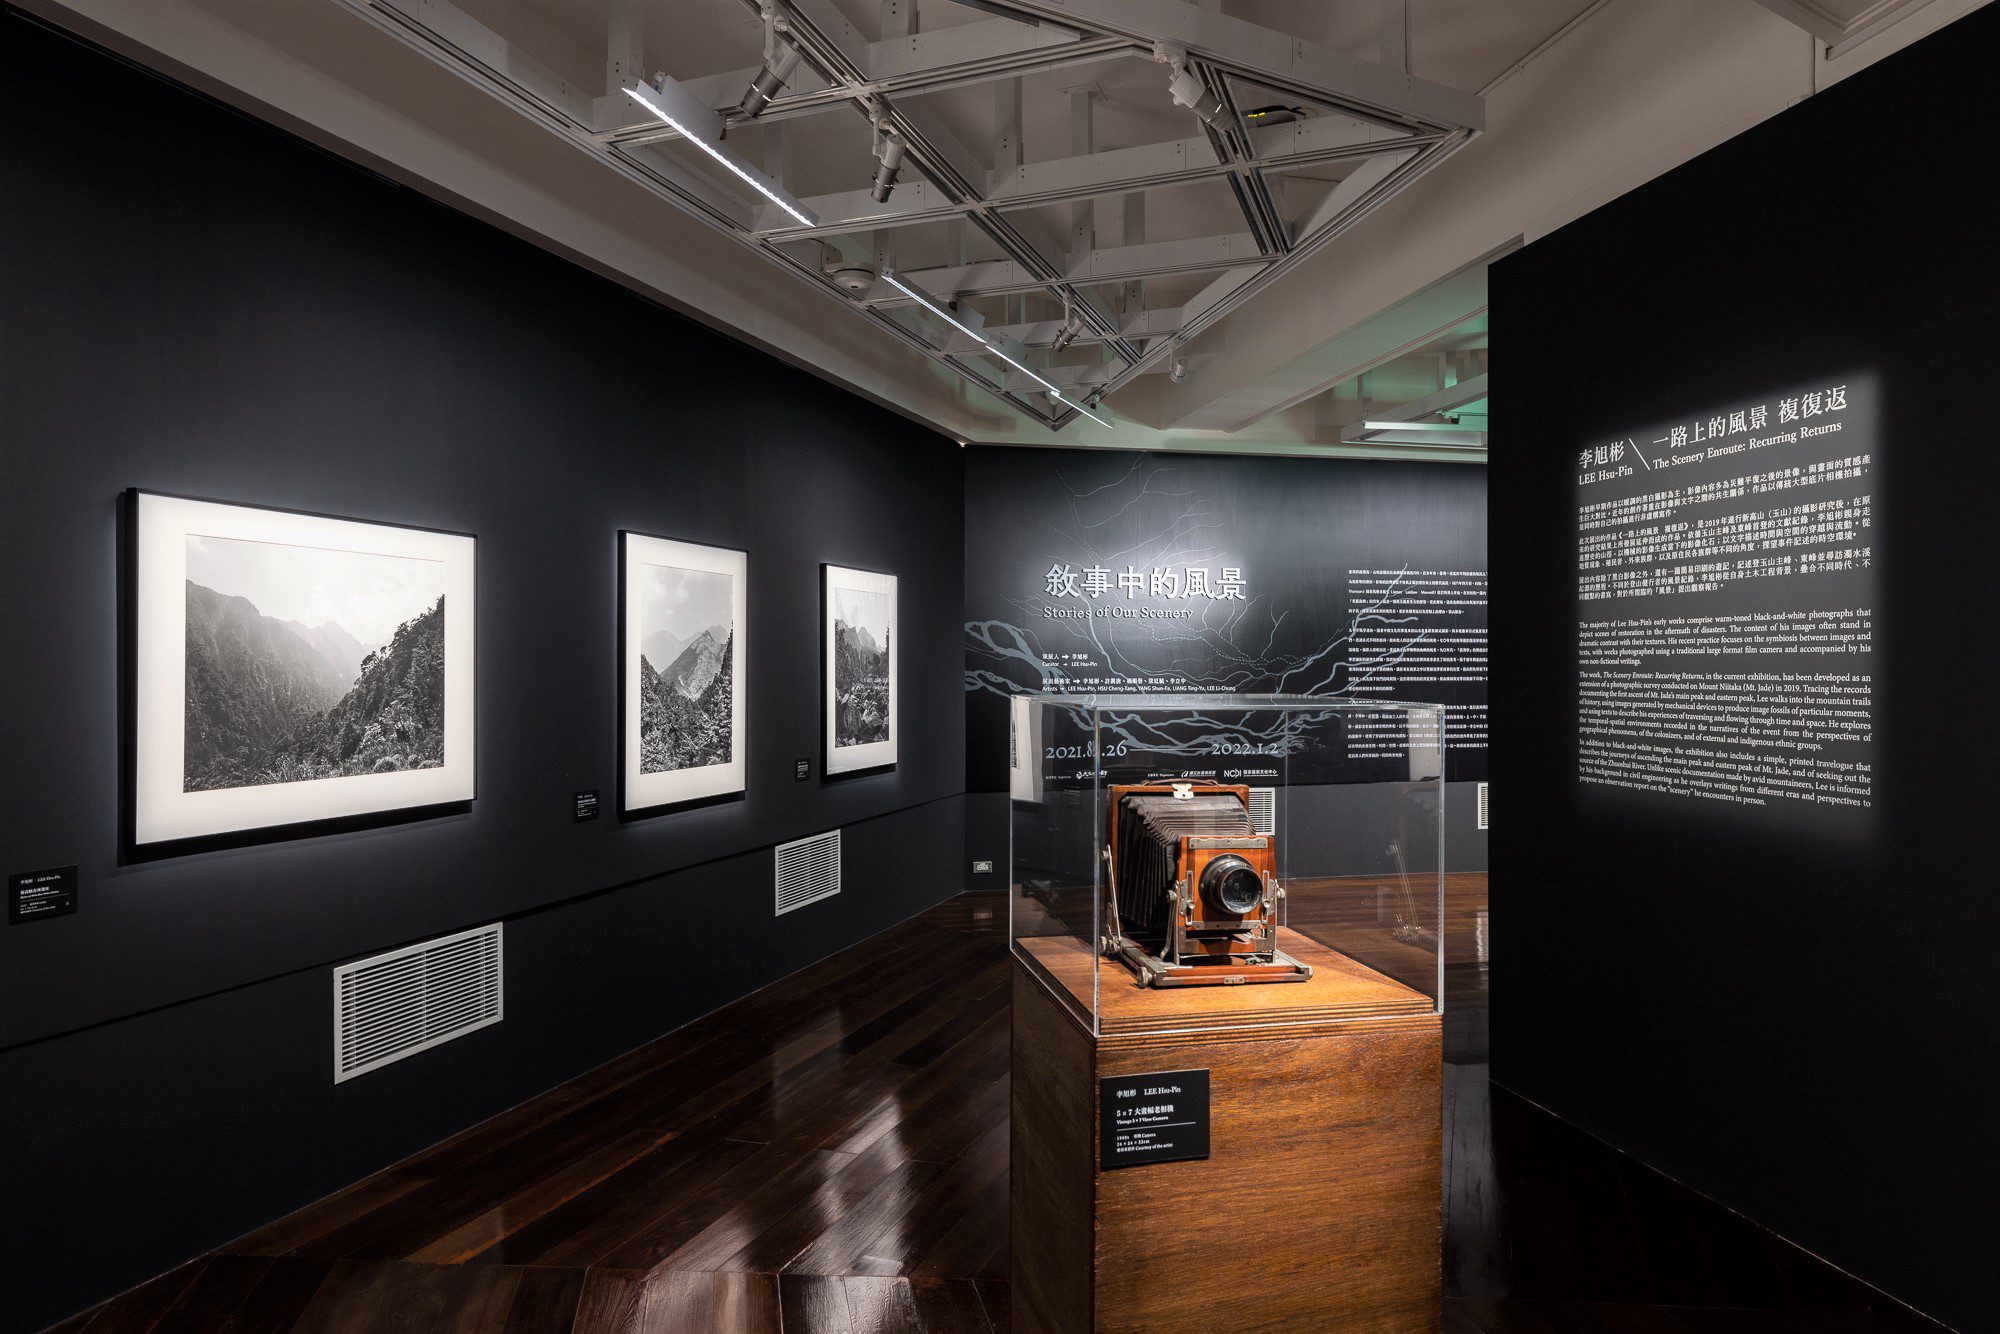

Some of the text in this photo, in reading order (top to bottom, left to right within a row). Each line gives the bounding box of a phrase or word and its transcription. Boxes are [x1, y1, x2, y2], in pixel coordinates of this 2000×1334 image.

[1652, 384, 1847, 448] 一路上的風景 複復返
[1652, 422, 1842, 469] The Scenery Enroute: Recurring Returns
[1579, 440, 1624, 469] 李旭彬
[1578, 464, 1633, 485] LEE Hsu-Pin
[1045, 563, 1246, 600] 敘事中的風景
[1043, 606, 1193, 621] Stories of Our Scenery
[1753, 607, 1871, 621] black-and-white photographs that
[1769, 619, 1871, 632] of his images often stand in
[1765, 631, 1871, 644] symbiosis between images and
[1784, 644, 1797, 653] and
[1799, 643, 1846, 654] accompanied
[1848, 643, 1858, 654] by
[1859, 643, 1871, 652] his
[1746, 672, 1781, 681] exhibition,
[1782, 672, 1794, 681] has
[1795, 672, 1812, 681] been
[1813, 672, 1850, 684] developed
[1757, 683, 1774, 693] Jade)
[1783, 684, 1801, 692] 2019.
[1802, 684, 1829, 695] Tracing
[1830, 684, 1842, 693] the
[1843, 684, 1871, 694] records
[1756, 694, 1871, 706] Lee walks into the mountain trails
[1750, 704, 1871, 718] image fossils of particular moments,
[1749, 715, 1871, 731] through time and space. He explores
[1783, 727, 1799, 737] from
[1802, 729, 1813, 738] the
[1816, 732, 1860, 741] perspectives
[1862, 732, 1872, 742] of
[1211, 743, 1278, 755] 2022.1.2
[1775, 738, 1823, 751] ethnic groups.
[1763, 754, 1871, 771] simple, printed travelogue that
[1762, 765, 1773, 773] Mt.
[1774, 766, 1791, 776] Jade,
[1792, 768, 1805, 776] and
[1806, 769, 1815, 777] of
[1815, 770, 1843, 782] seeking
[1858, 774, 1871, 783] the
[1766, 778, 1871, 795] mountaineers, Lee is informed
[1756, 785, 1784, 796] different
[1801, 792, 1815, 800] and
[1817, 795, 1860, 806] perspectives
